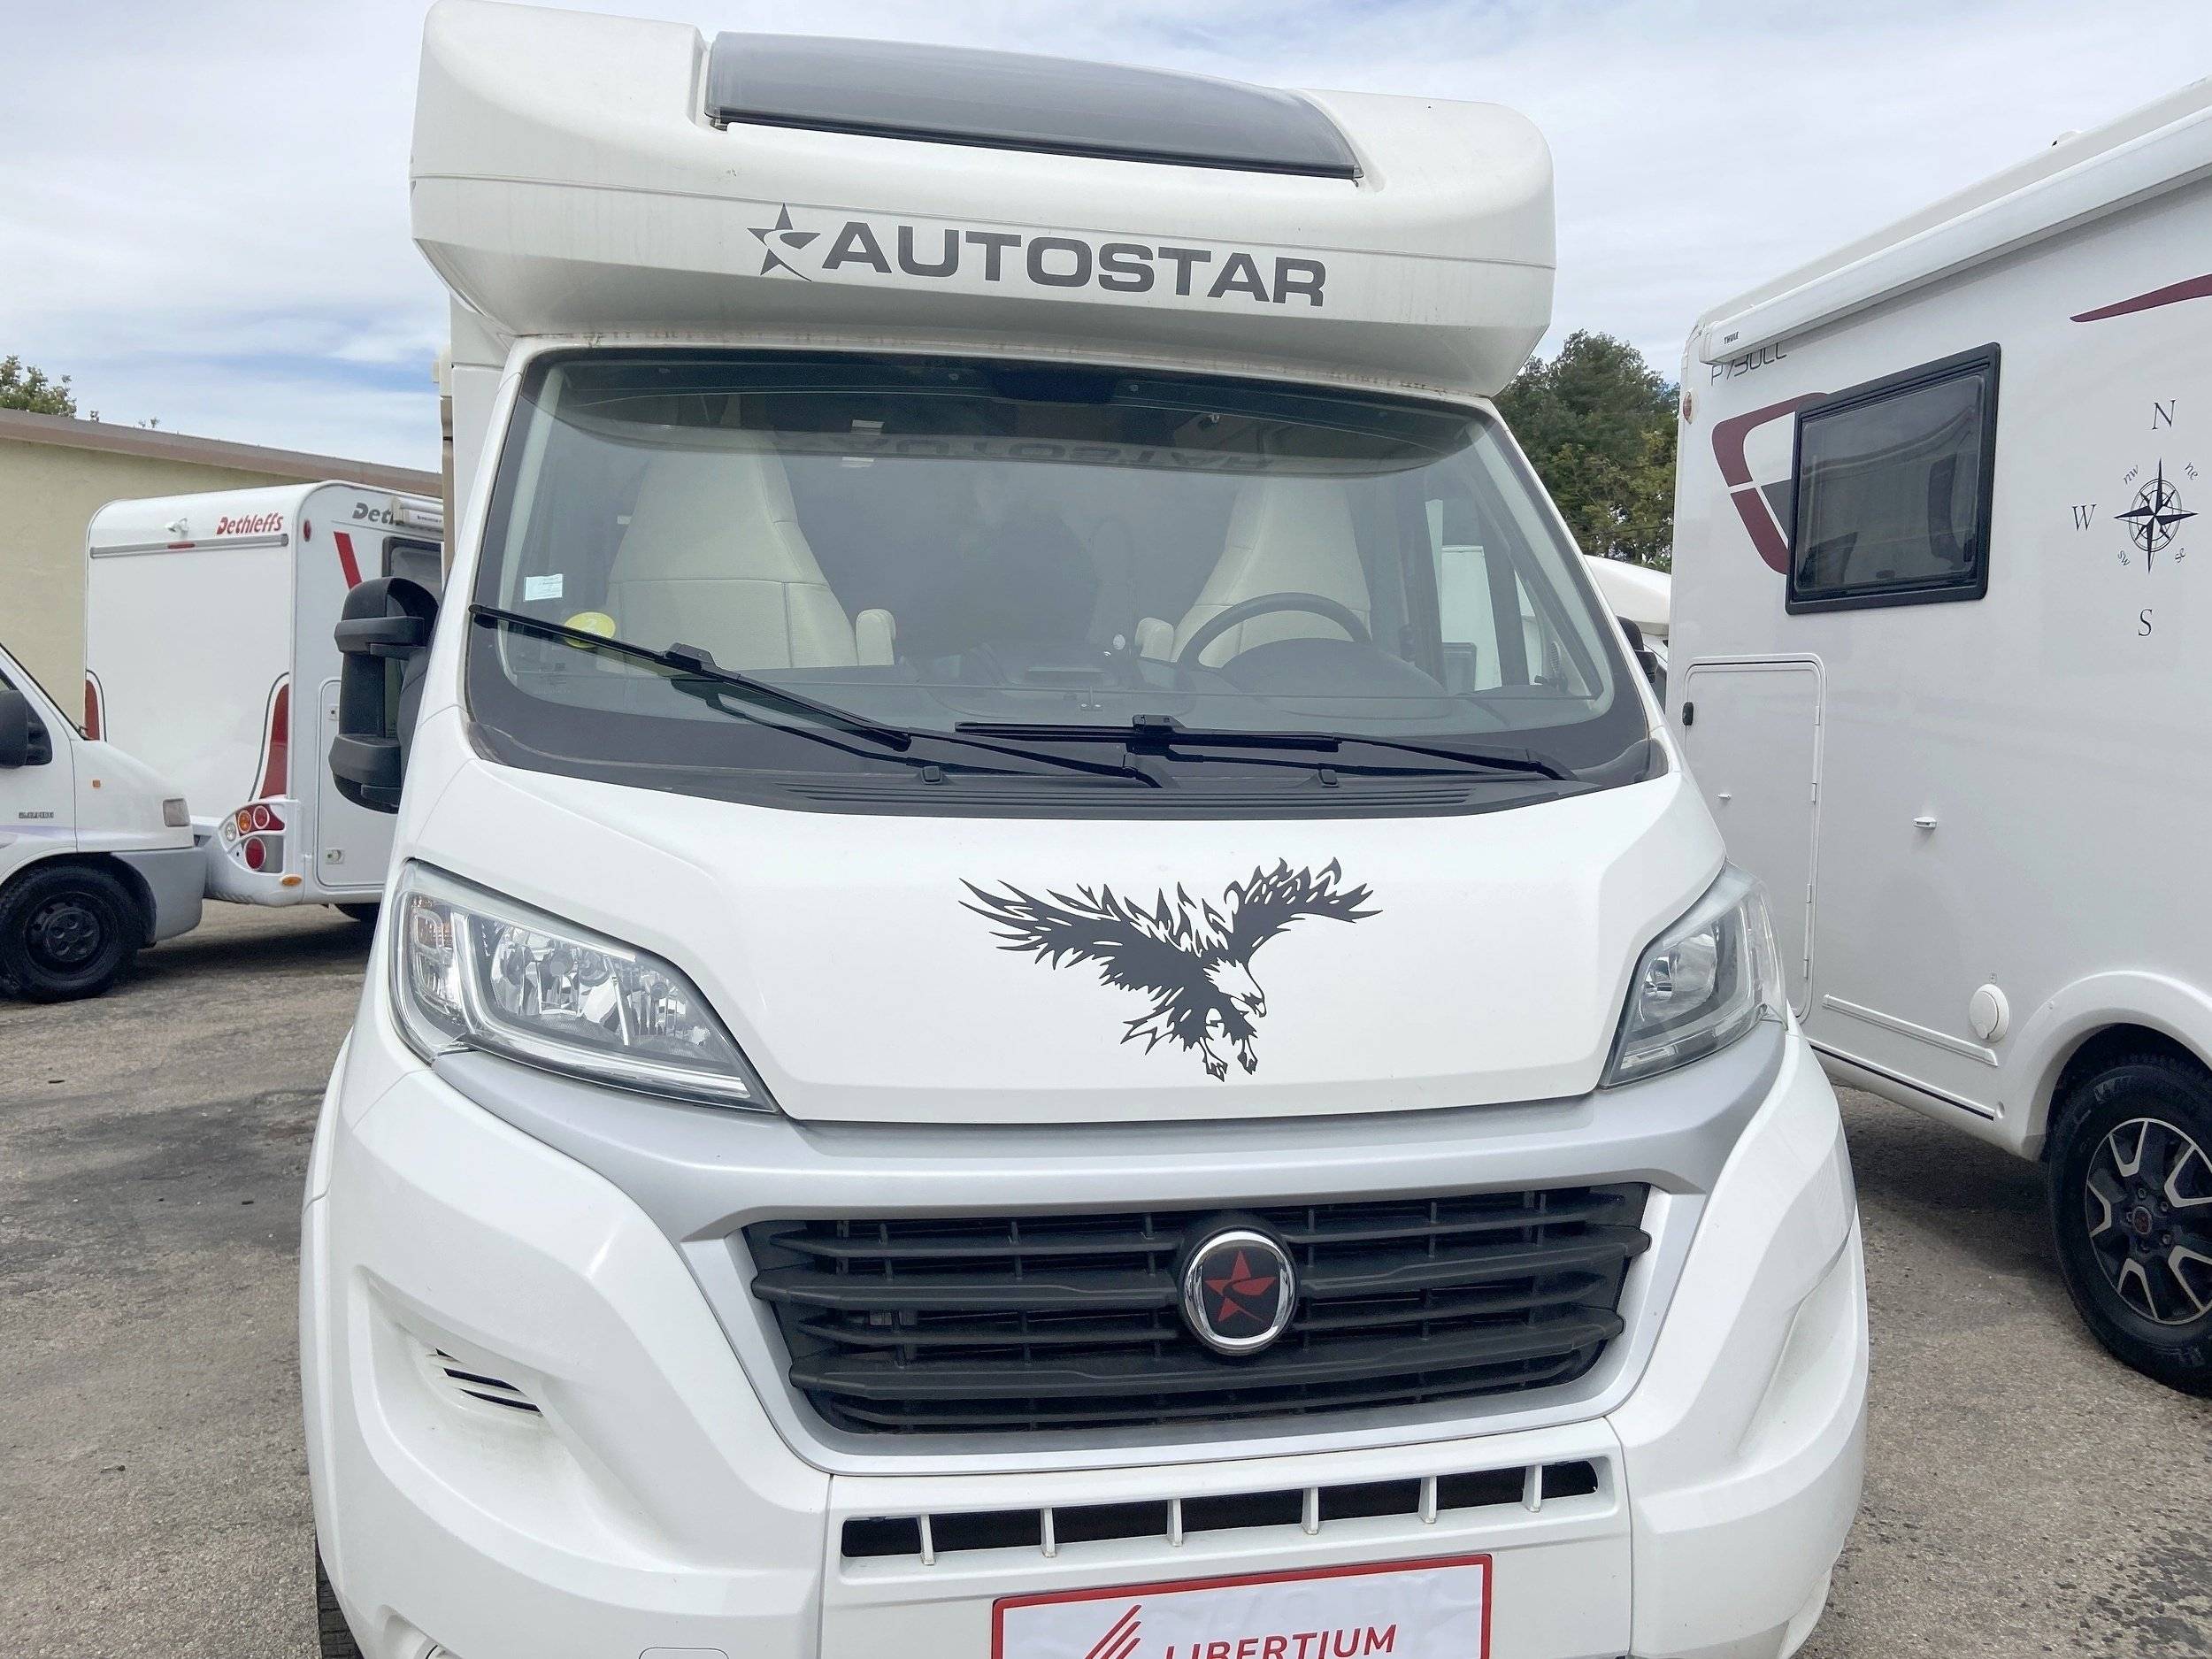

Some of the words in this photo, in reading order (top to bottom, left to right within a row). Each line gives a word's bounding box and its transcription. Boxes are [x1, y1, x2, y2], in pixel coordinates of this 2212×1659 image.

[821, 221, 1325, 307] AUTOSTAR
[2151, 399, 2176, 430] N
[2123, 464, 2139, 486] nw
[216, 511, 284, 535] Dethleffs
[352, 502, 395, 525] Det
[2071, 503, 2098, 532] W
[2116, 549, 2131, 566] sw
[2174, 547, 2187, 564] se
[2137, 608, 2154, 636] S
